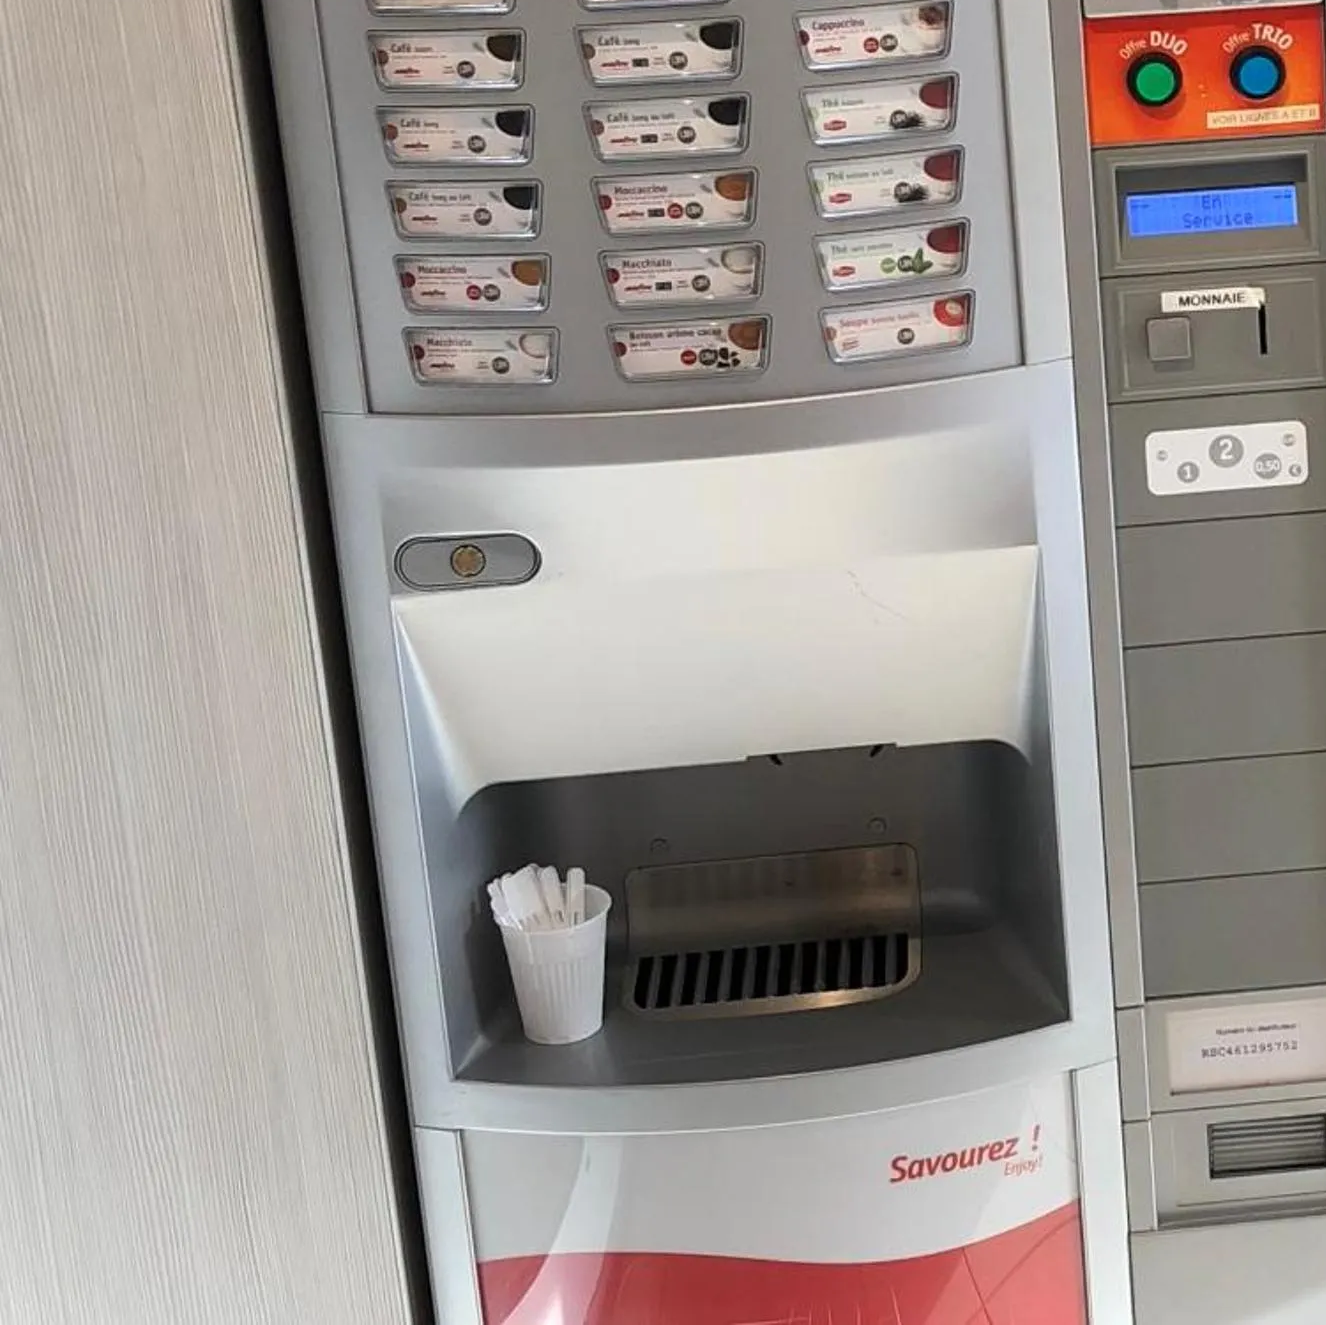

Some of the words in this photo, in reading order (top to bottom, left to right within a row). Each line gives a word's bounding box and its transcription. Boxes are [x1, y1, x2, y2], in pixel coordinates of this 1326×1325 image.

[597, 36, 620, 47] Café
[1118, 38, 1147, 60] Offre
[1150, 30, 1188, 56] DUO
[1222, 31, 1250, 54] Offre
[1250, 22, 1294, 51] TRIO
[390, 42, 412, 53] Café
[400, 118, 421, 128] Café
[606, 112, 629, 123] Café
[408, 191, 429, 201] Café
[1201, 194, 1222, 210] En
[1182, 211, 1254, 229] Service
[1178, 292, 1246, 307] MONNAIE
[1219, 438, 1234, 461] 2
[1183, 465, 1192, 479] 1
[888, 1136, 1020, 1184] Savourez
